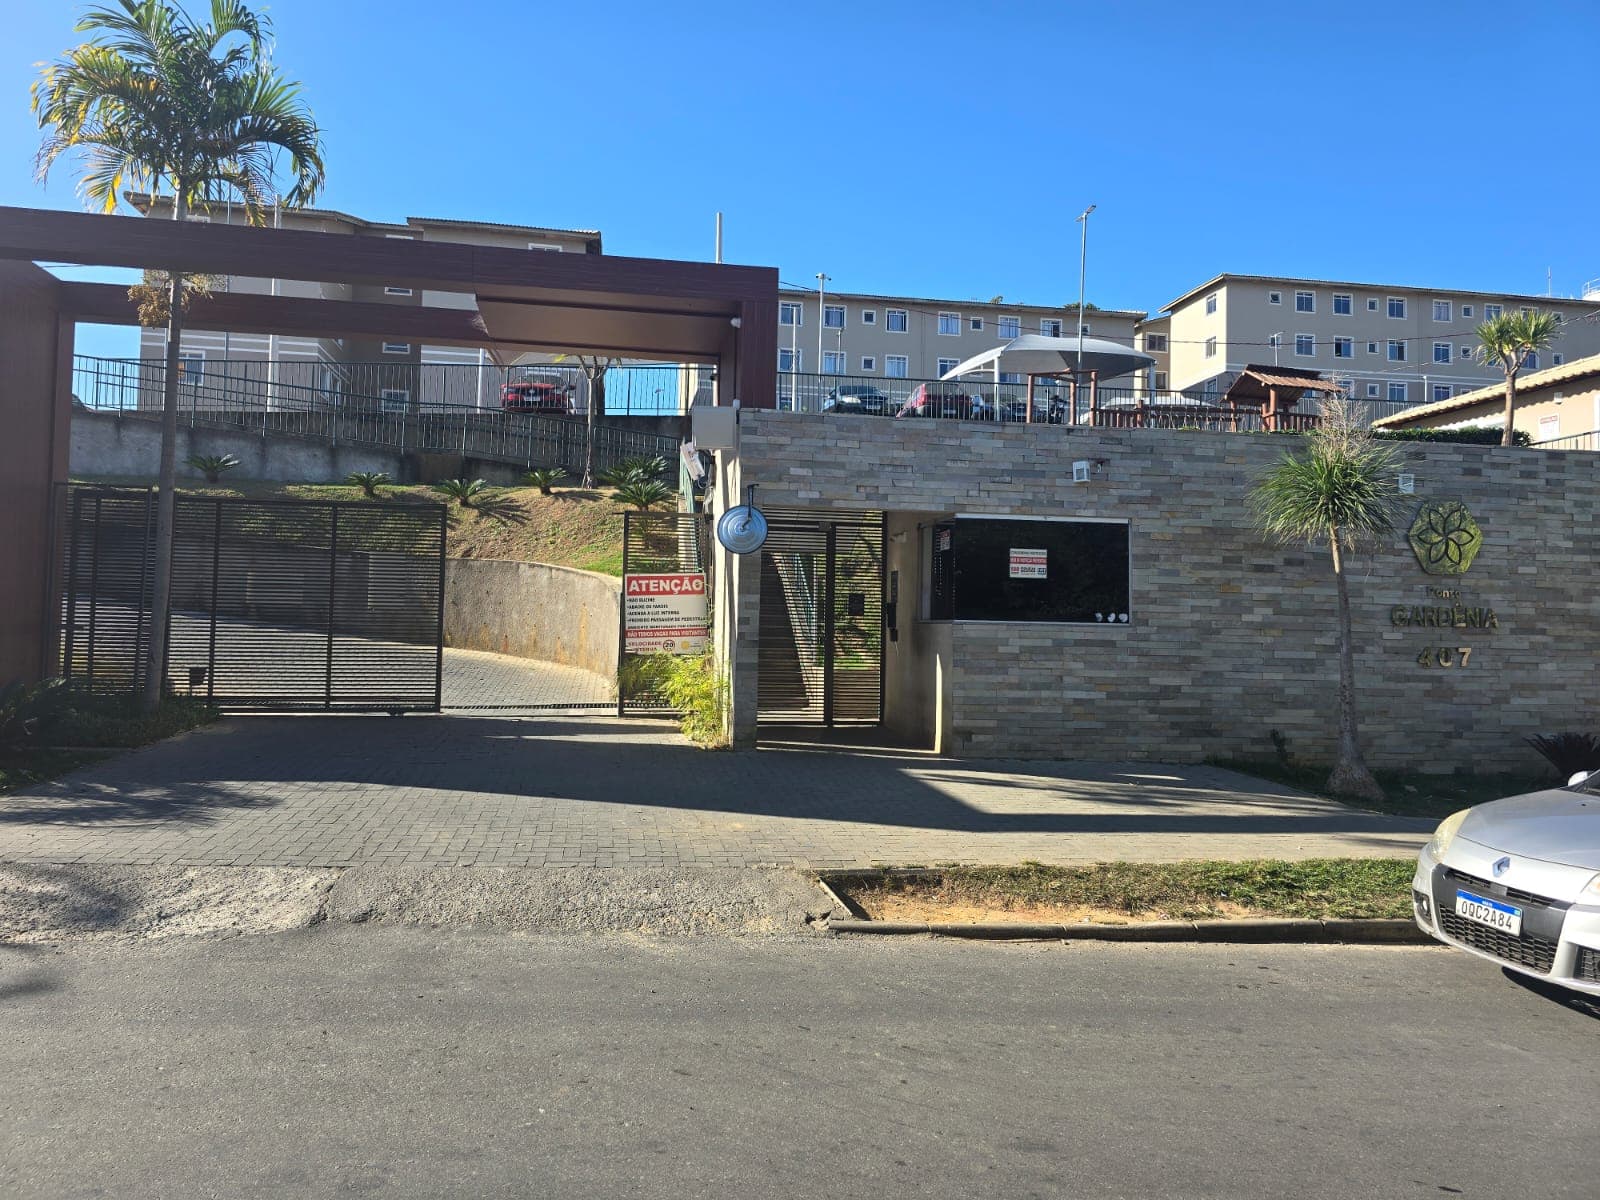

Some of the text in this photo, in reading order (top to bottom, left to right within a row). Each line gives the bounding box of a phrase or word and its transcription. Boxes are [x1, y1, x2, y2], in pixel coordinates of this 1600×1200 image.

[629, 577, 704, 594] ATENÇÃO
[1391, 602, 1498, 628] GARDÊNIA
[1418, 647, 1472, 667] 407
[1462, 901, 1512, 930] OQC2A84
